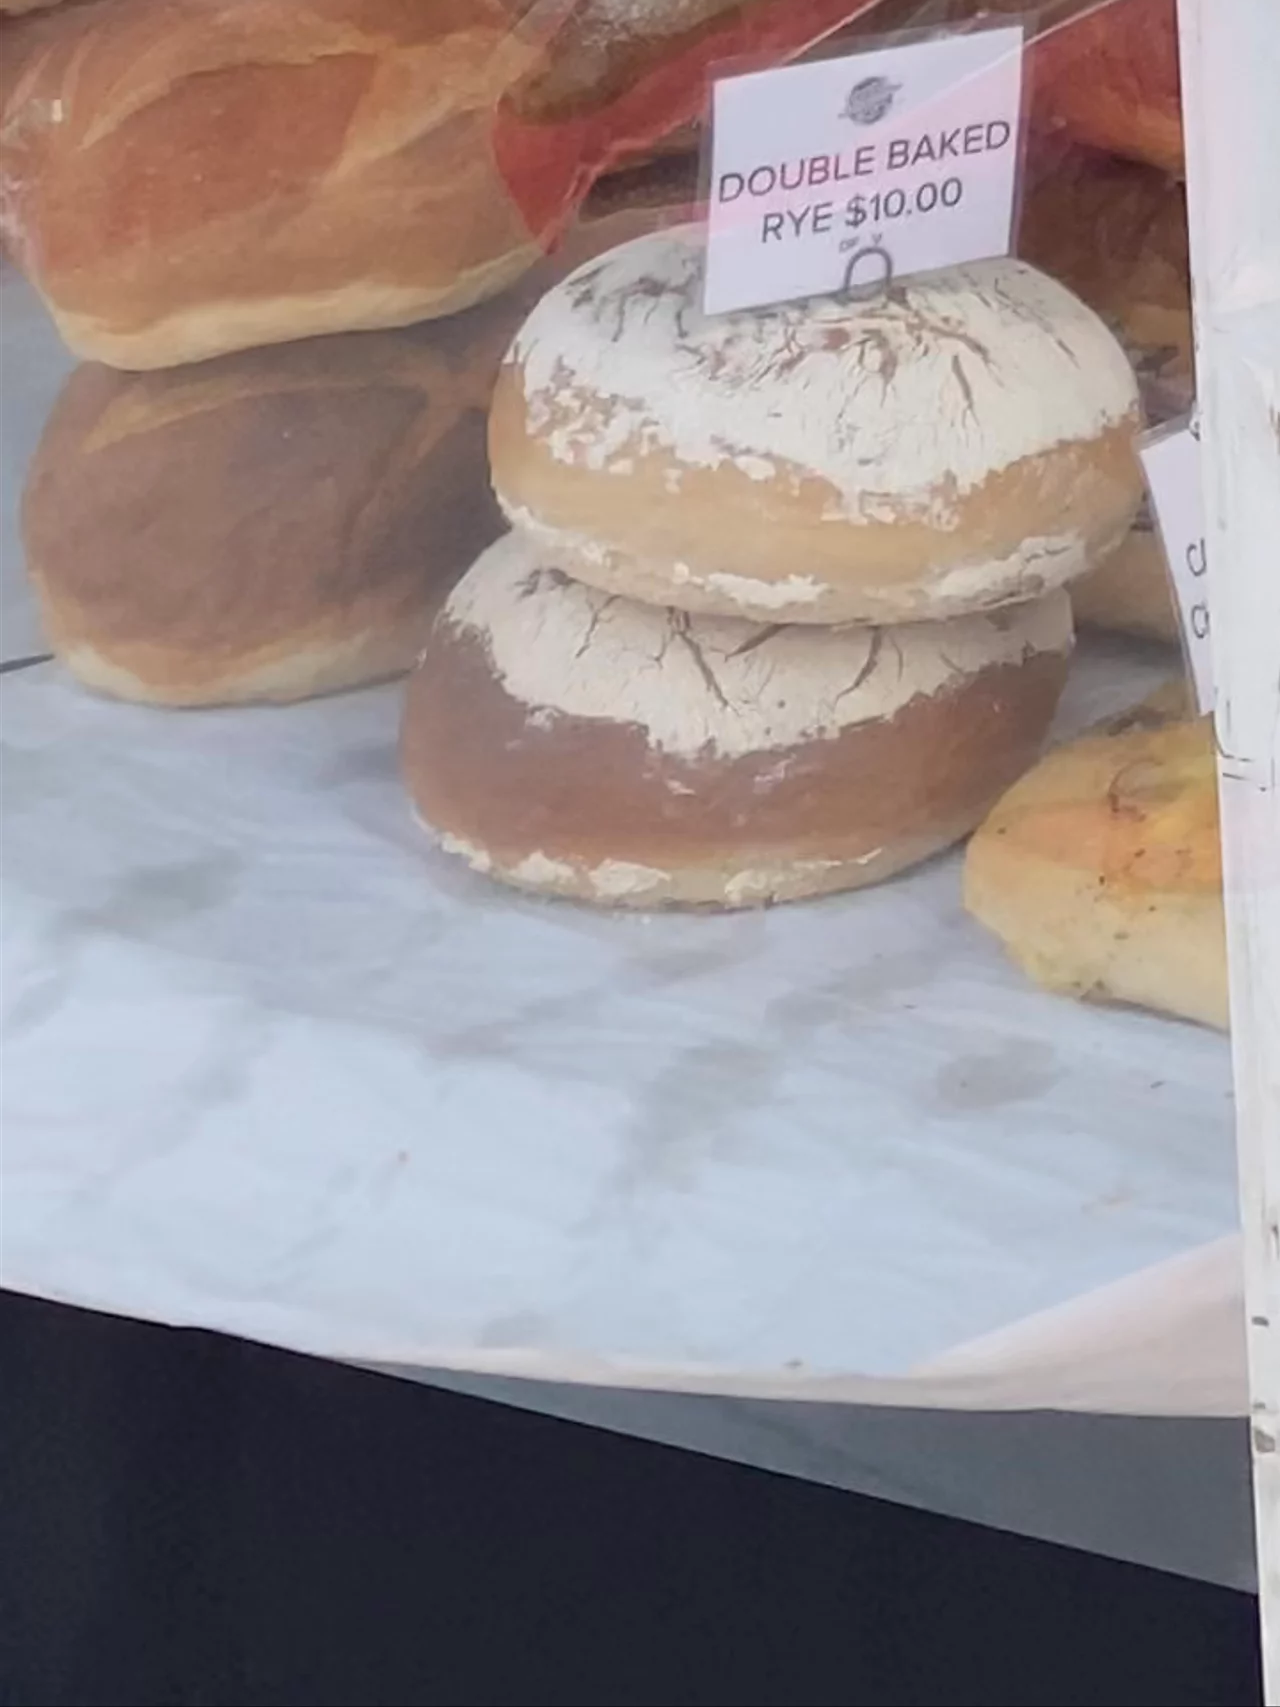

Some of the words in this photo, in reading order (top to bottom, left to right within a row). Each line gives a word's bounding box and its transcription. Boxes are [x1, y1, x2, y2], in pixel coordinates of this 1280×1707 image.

[718, 144, 876, 203] DOUBLE
[886, 120, 1011, 170] BAKED
[761, 202, 834, 243] RYE
[844, 176, 964, 228] $10.00
